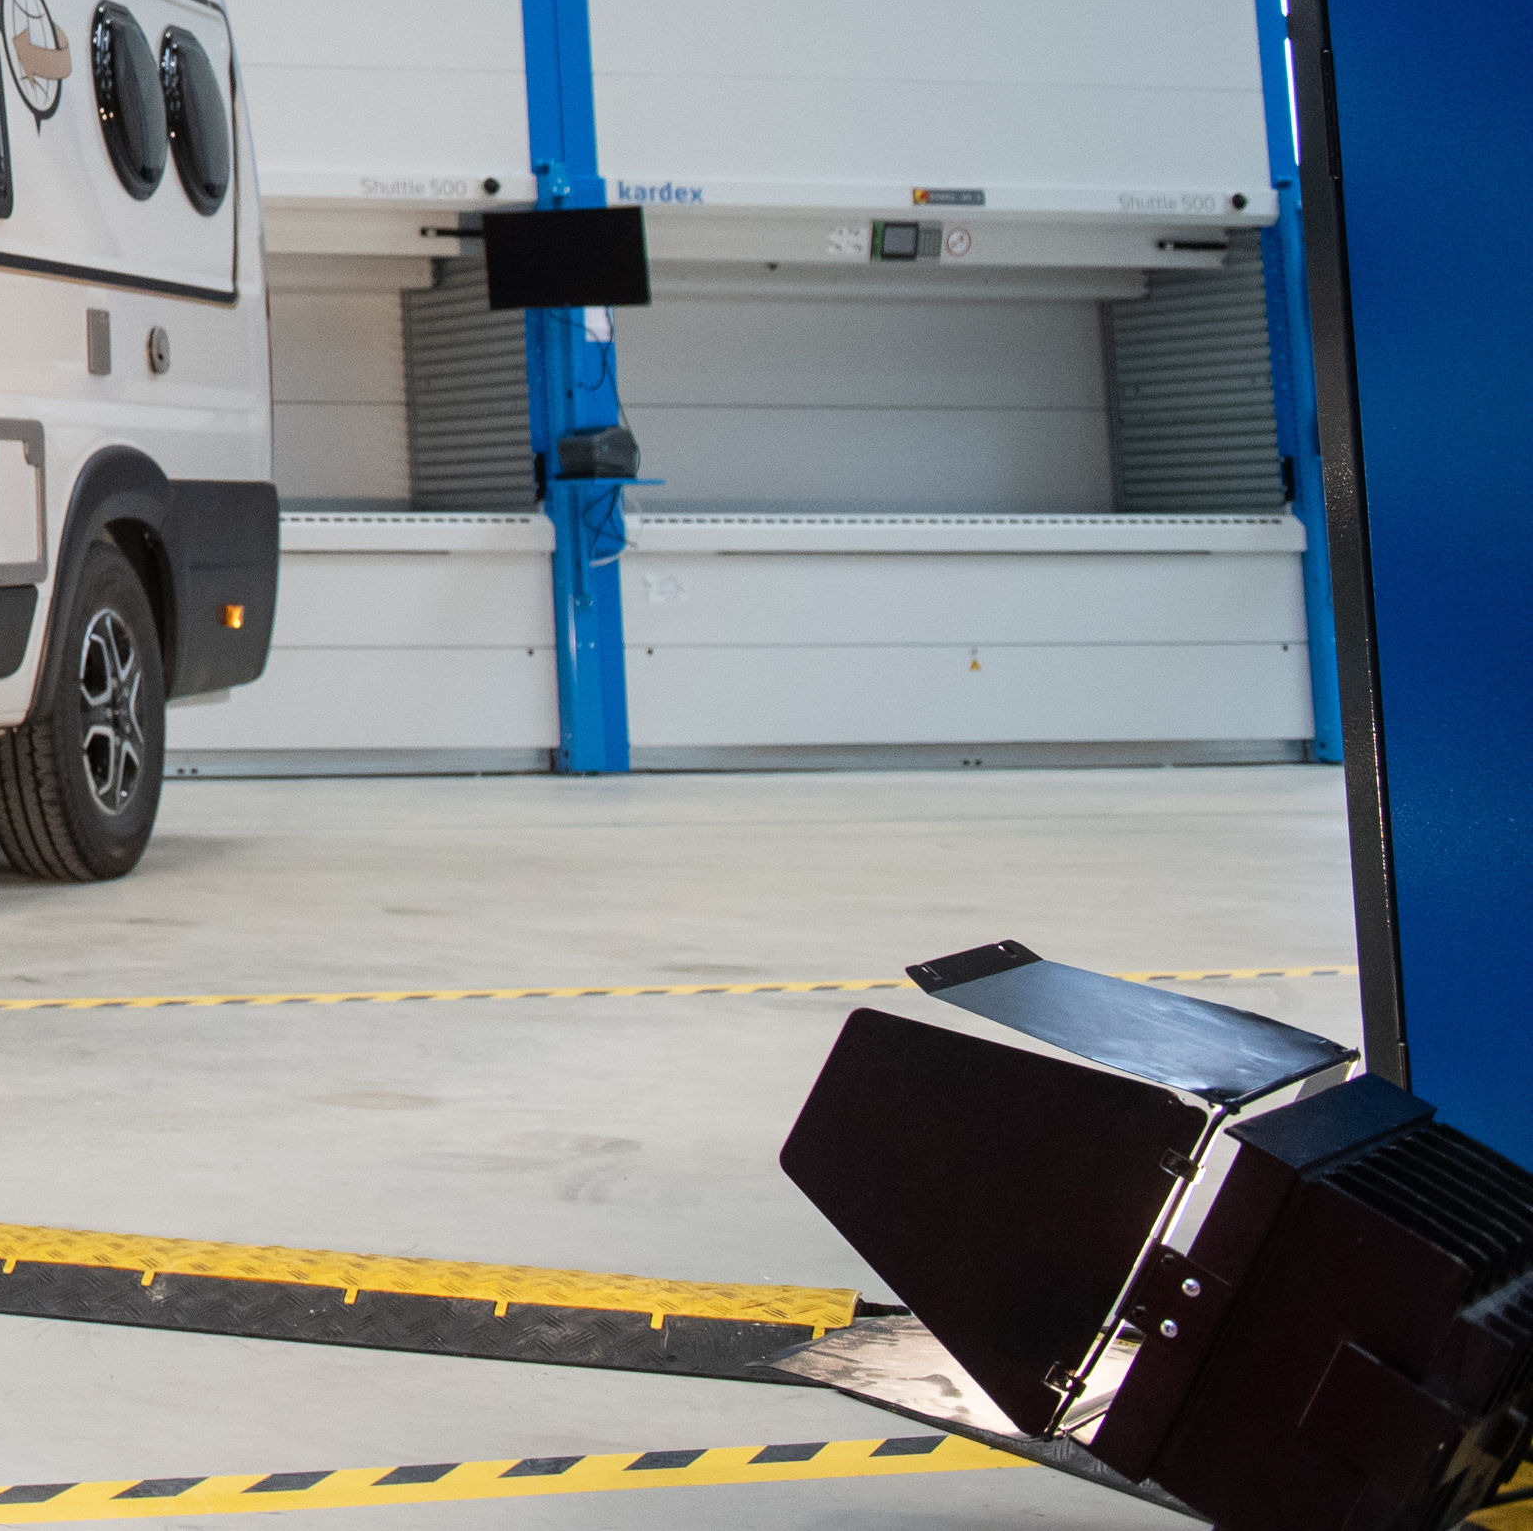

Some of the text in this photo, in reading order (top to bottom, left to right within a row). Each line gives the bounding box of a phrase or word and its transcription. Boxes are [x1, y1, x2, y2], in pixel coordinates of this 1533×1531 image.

[360, 177, 467, 196] Shuttle 500
[618, 180, 703, 204] kardex
[1118, 193, 1216, 211] Shuttle 500
